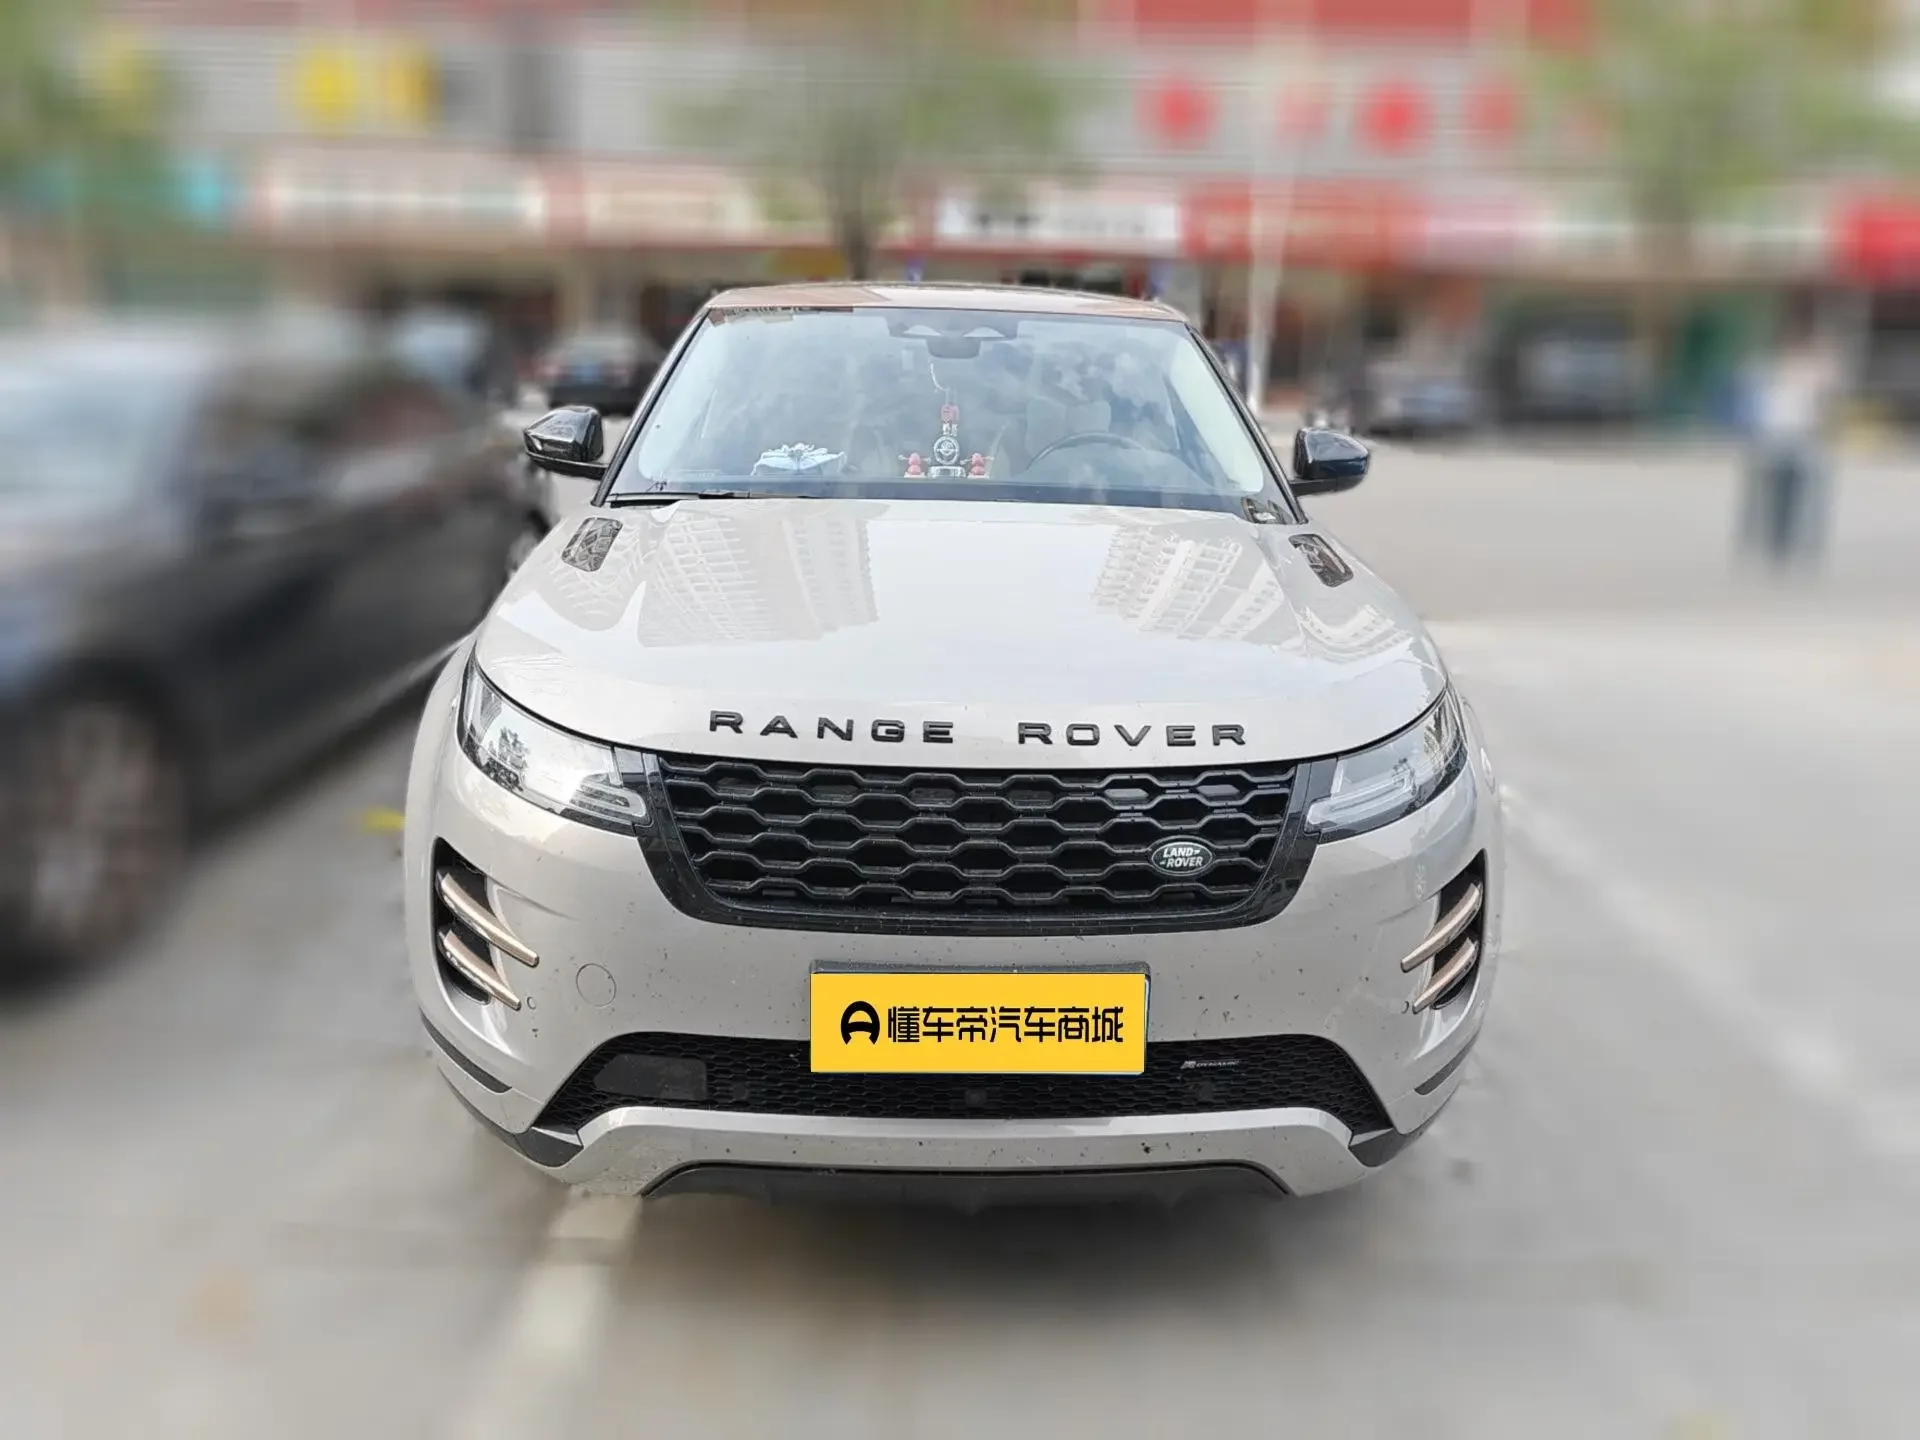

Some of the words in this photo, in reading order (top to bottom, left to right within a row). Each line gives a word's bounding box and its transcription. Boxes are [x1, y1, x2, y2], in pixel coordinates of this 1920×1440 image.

[709, 710, 954, 743] RANGE
[1018, 722, 1246, 747] ROVER
[1163, 847, 1194, 858] LAND
[1166, 856, 1203, 868] ROVER
